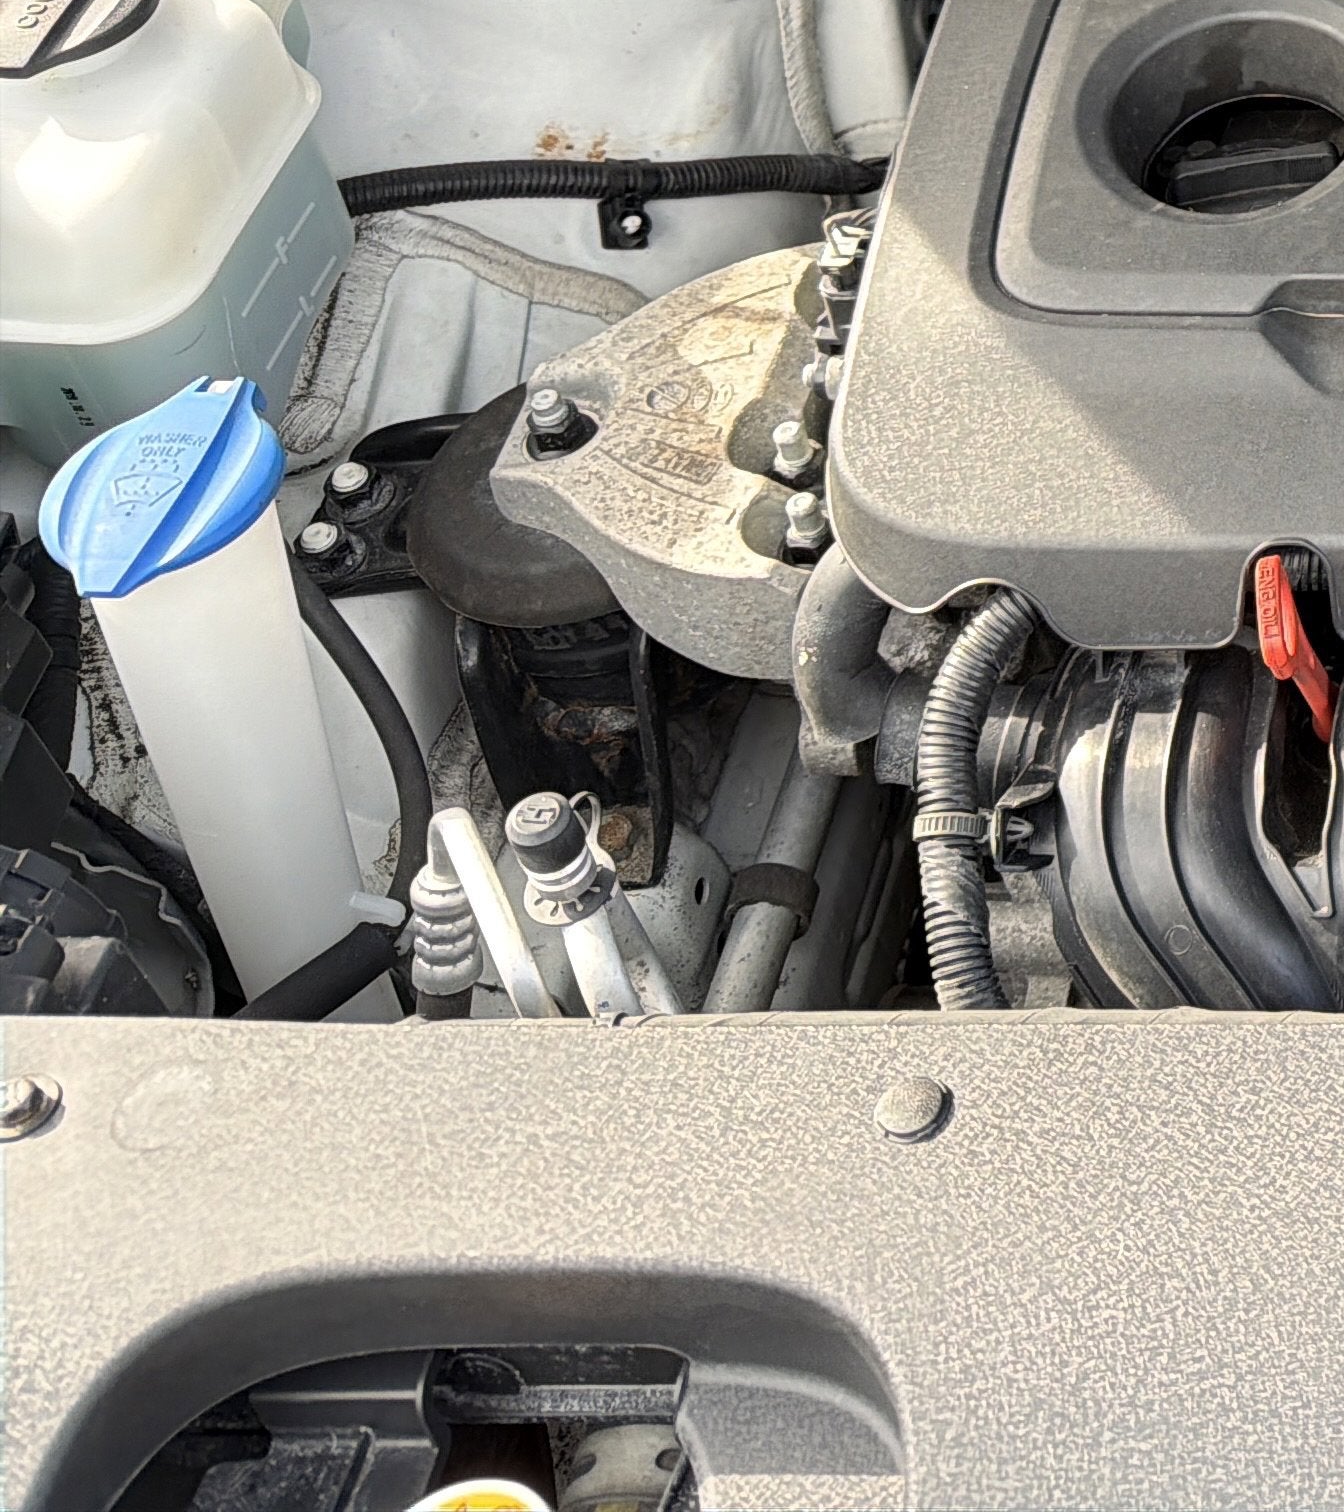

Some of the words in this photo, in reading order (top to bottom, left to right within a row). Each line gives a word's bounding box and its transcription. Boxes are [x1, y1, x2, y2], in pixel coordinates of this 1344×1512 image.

[276, 236, 290, 265] F
[138, 432, 208, 448] WASHER
[142, 446, 187, 458] ONLY
[1259, 566, 1276, 601] ENG
[1262, 605, 1281, 640] OIL
